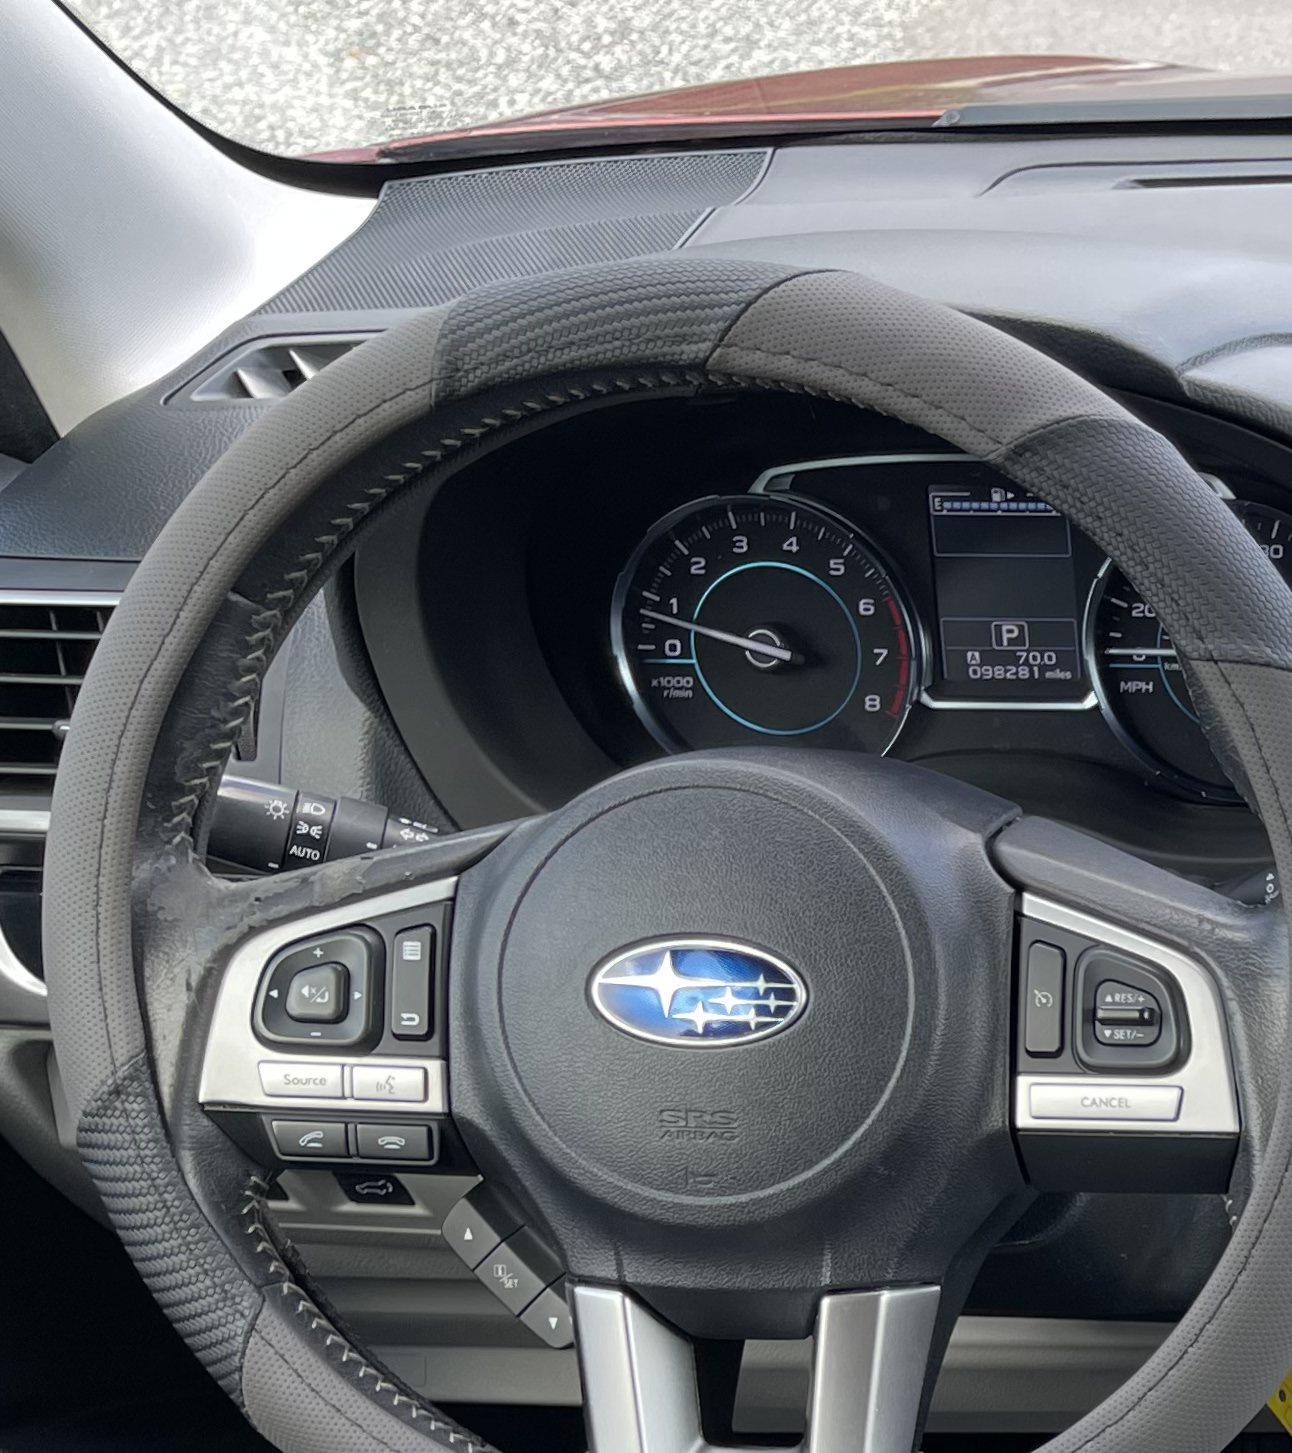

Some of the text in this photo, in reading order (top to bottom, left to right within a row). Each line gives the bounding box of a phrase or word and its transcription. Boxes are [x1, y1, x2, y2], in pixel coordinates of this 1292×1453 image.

[732, 537, 748, 554] 3
[782, 537, 800, 553] 4
[689, 557, 707, 575] 2
[829, 560, 846, 576] 5
[669, 598, 679, 614] 1
[858, 599, 876, 616] 6
[1001, 624, 1020, 647] P
[664, 639, 682, 656] 0
[873, 650, 889, 666] 7
[1015, 651, 1057, 665] 70.0
[968, 666, 1073, 679] 098281 miles
[651, 676, 694, 688] x1000
[1119, 681, 1153, 693] MPH
[662, 688, 693, 699] r/min
[865, 695, 881, 712] 8
[289, 844, 321, 861] AUTO
[283, 1074, 327, 1086] Source
[1080, 1096, 1131, 1109] CANCEL
[659, 1109, 738, 1128] SRS
